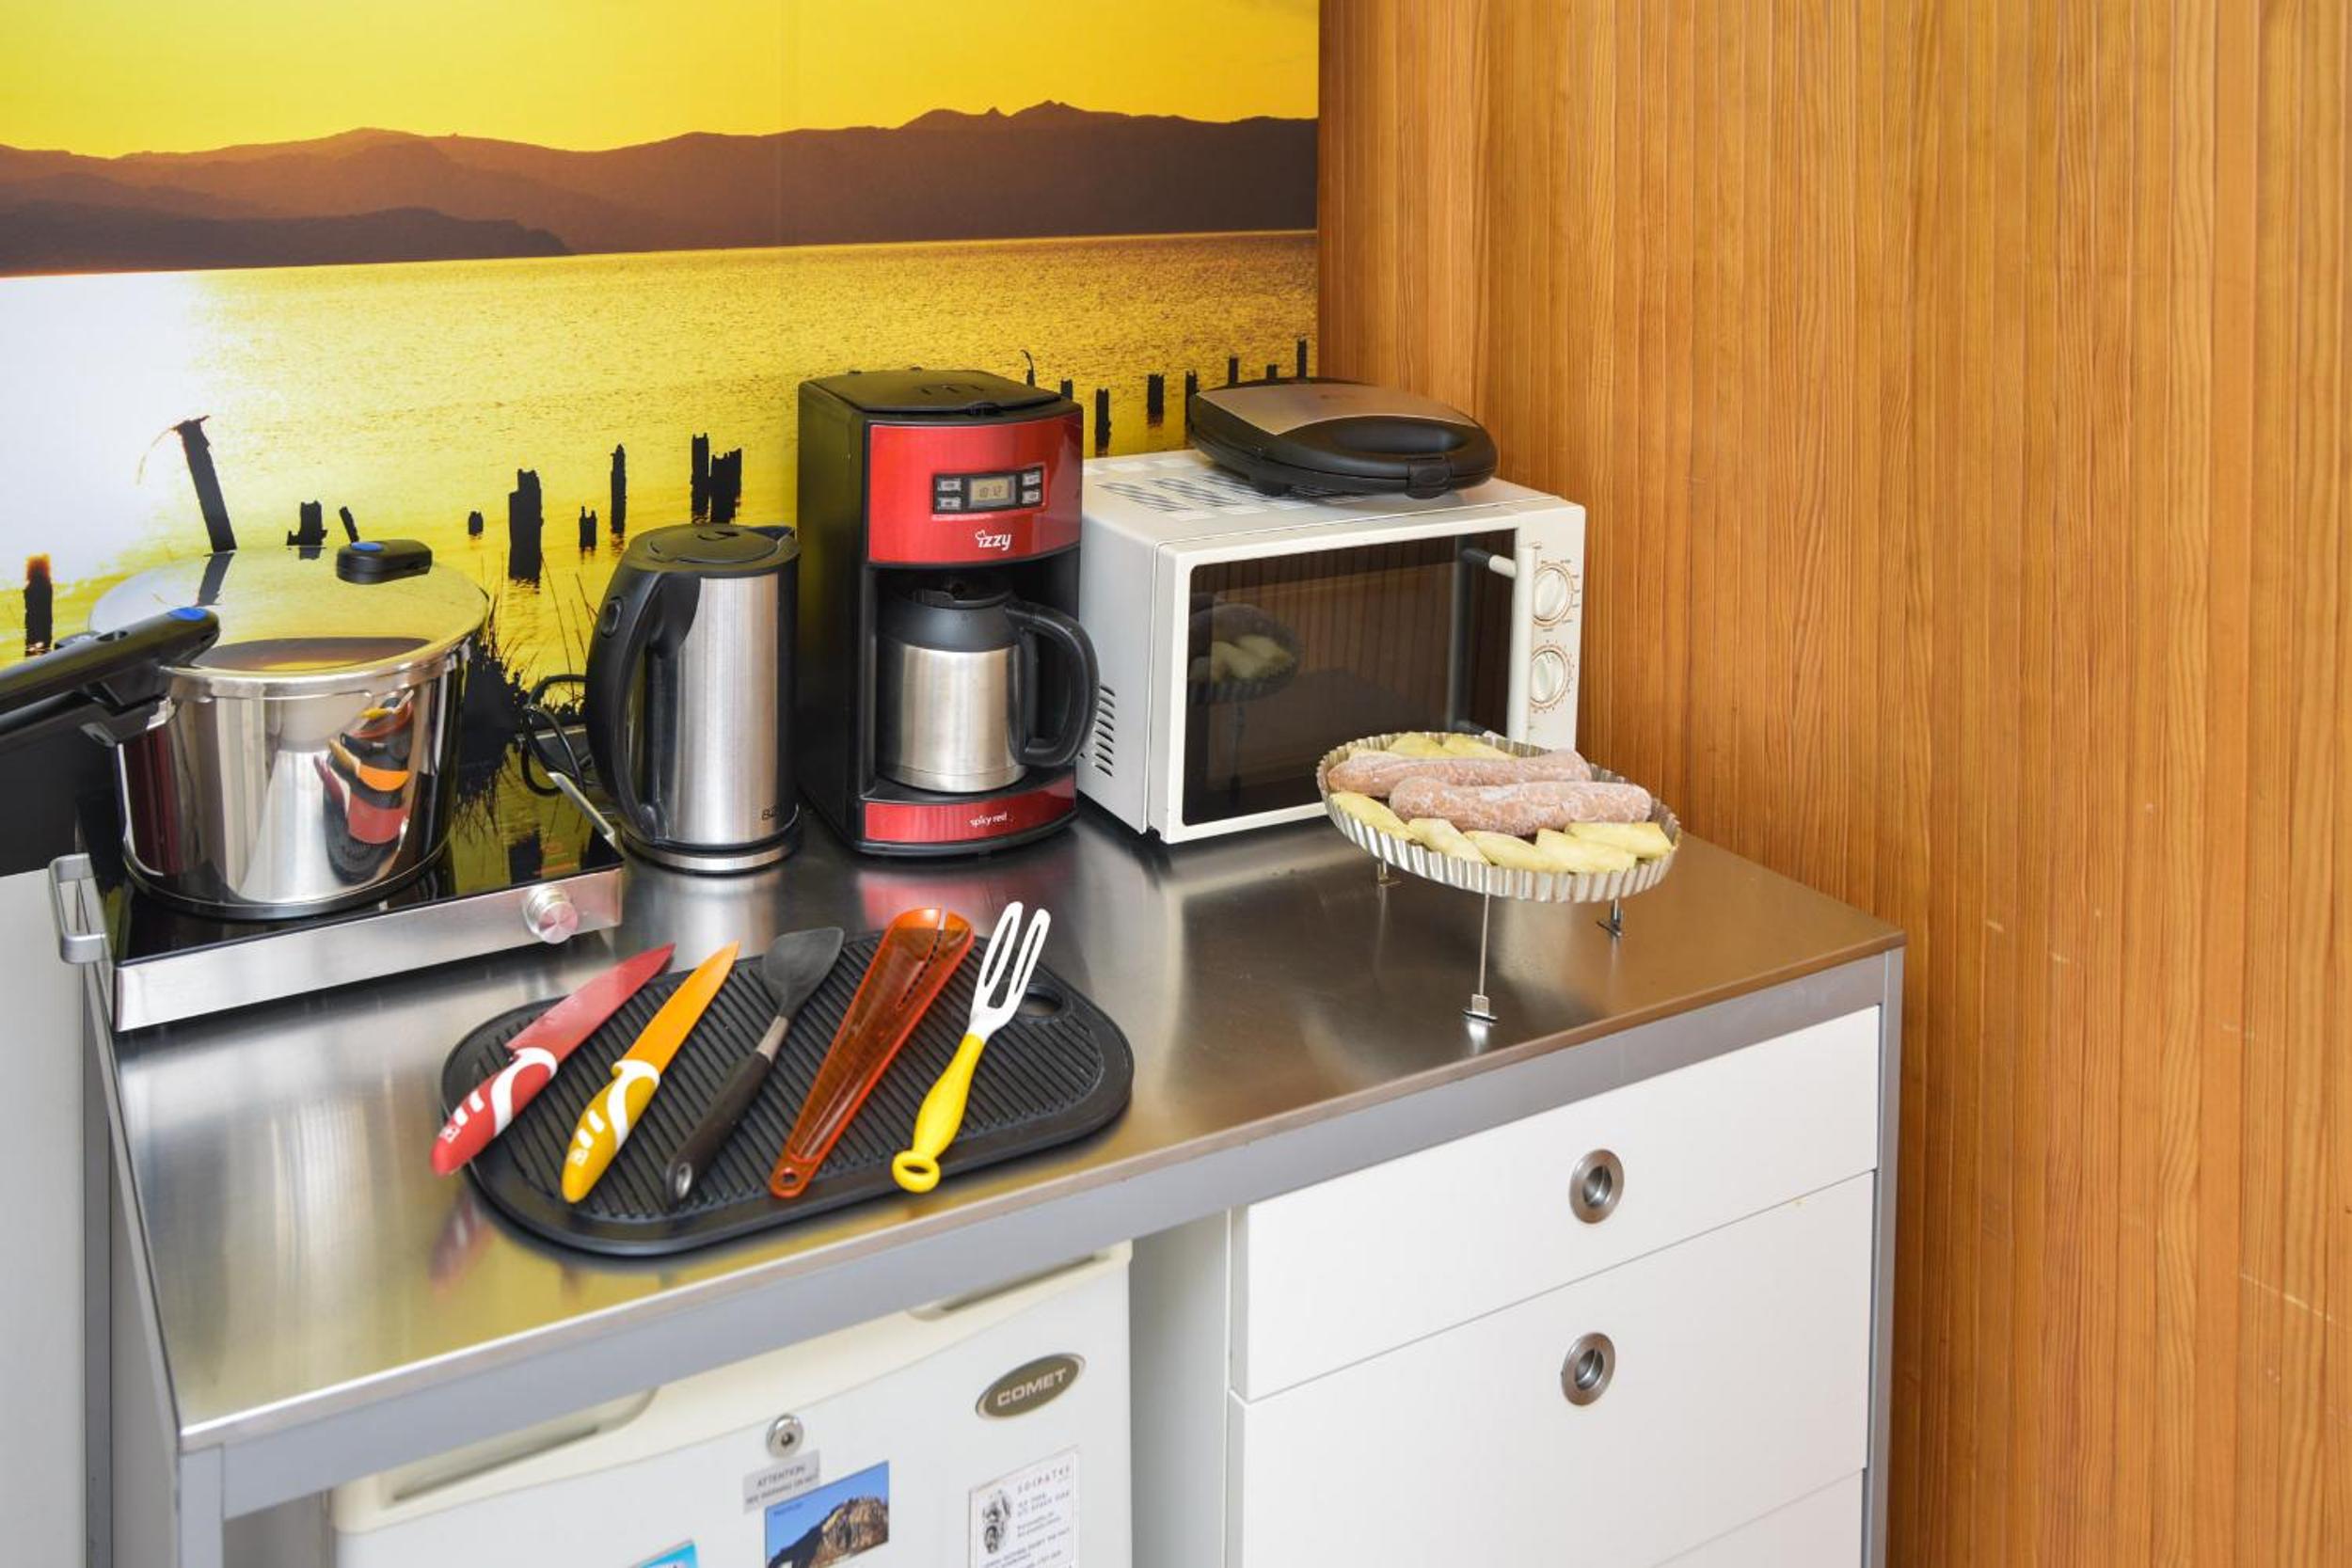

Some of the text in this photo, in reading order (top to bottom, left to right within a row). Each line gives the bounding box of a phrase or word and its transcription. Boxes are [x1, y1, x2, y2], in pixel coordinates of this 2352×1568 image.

[993, 811, 1008, 823] red
[997, 1368, 1066, 1407] COMET
[757, 1463, 805, 1487] ATTENTION
